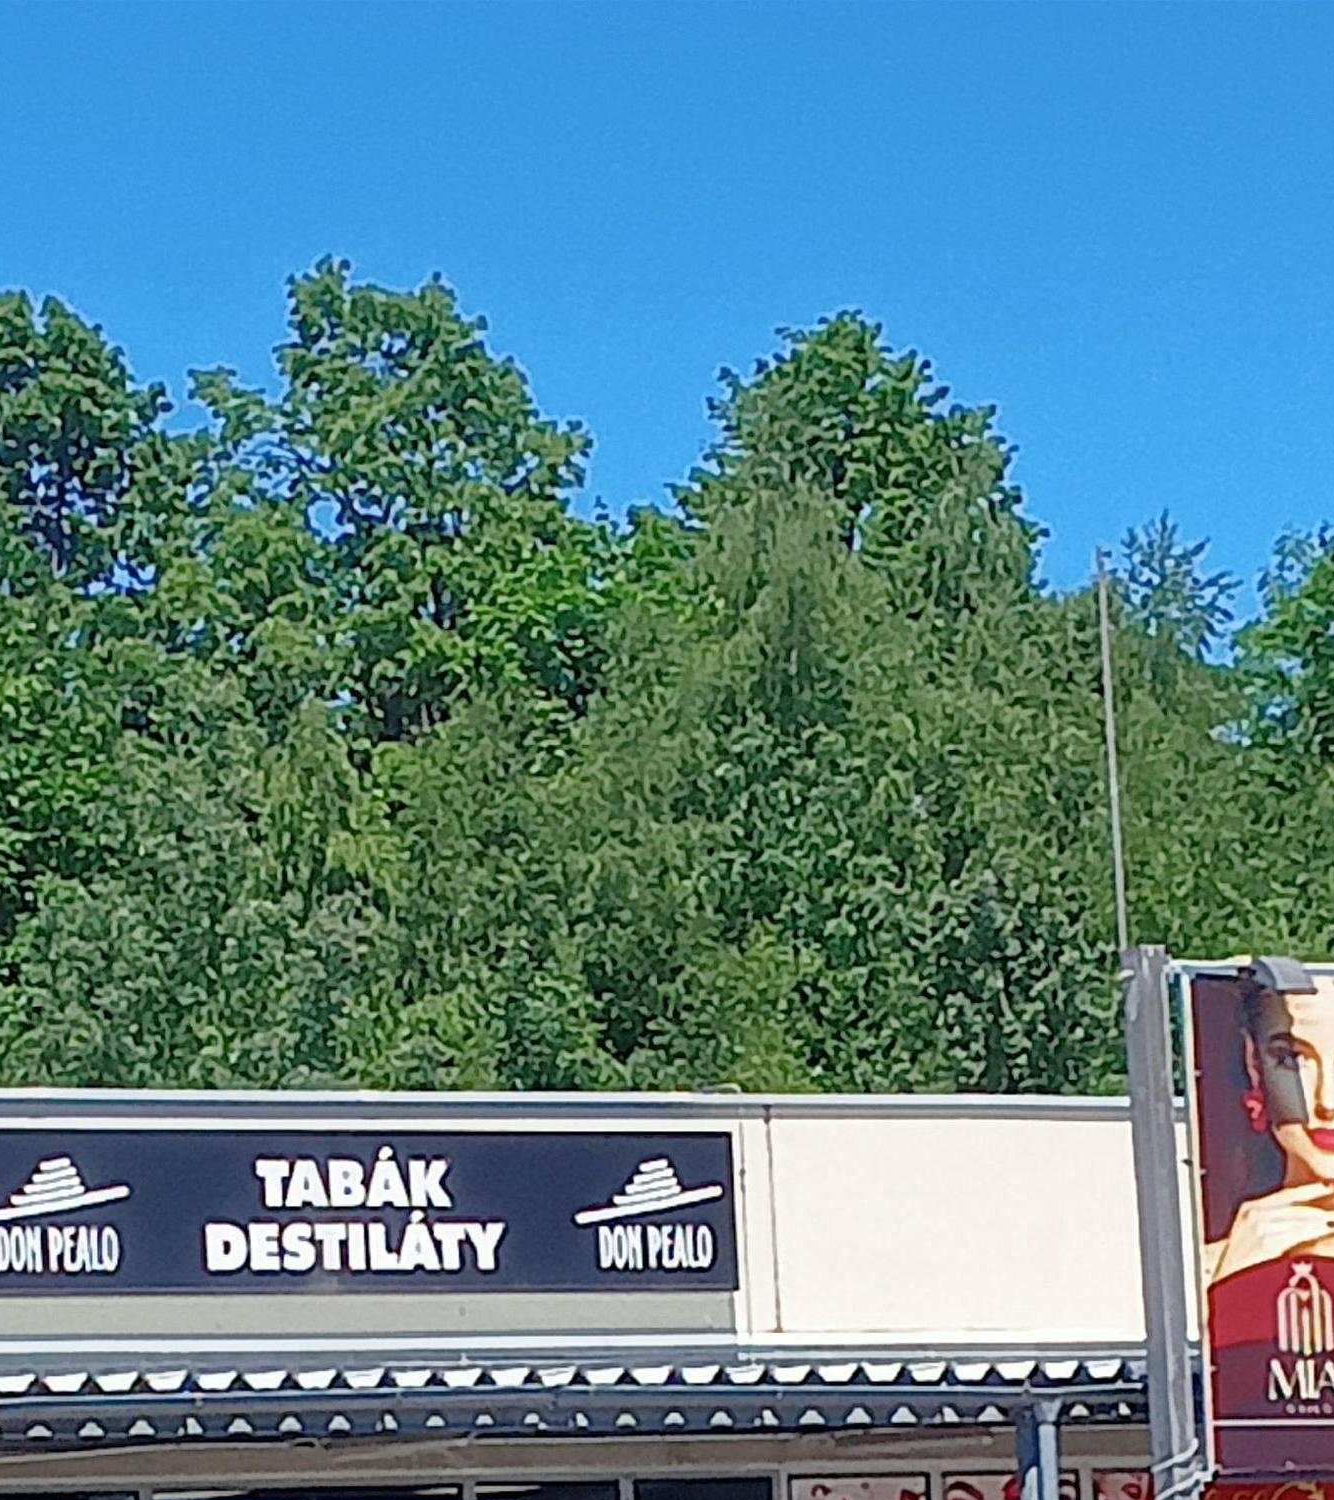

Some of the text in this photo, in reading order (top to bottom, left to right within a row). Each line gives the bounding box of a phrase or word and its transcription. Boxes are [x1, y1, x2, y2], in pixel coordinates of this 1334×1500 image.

[255, 1146, 452, 1209] TABÁK
[47, 1225, 119, 1272] PEALO
[204, 1211, 506, 1273] DESTILÁTY
[598, 1224, 713, 1270] DON PEALO
